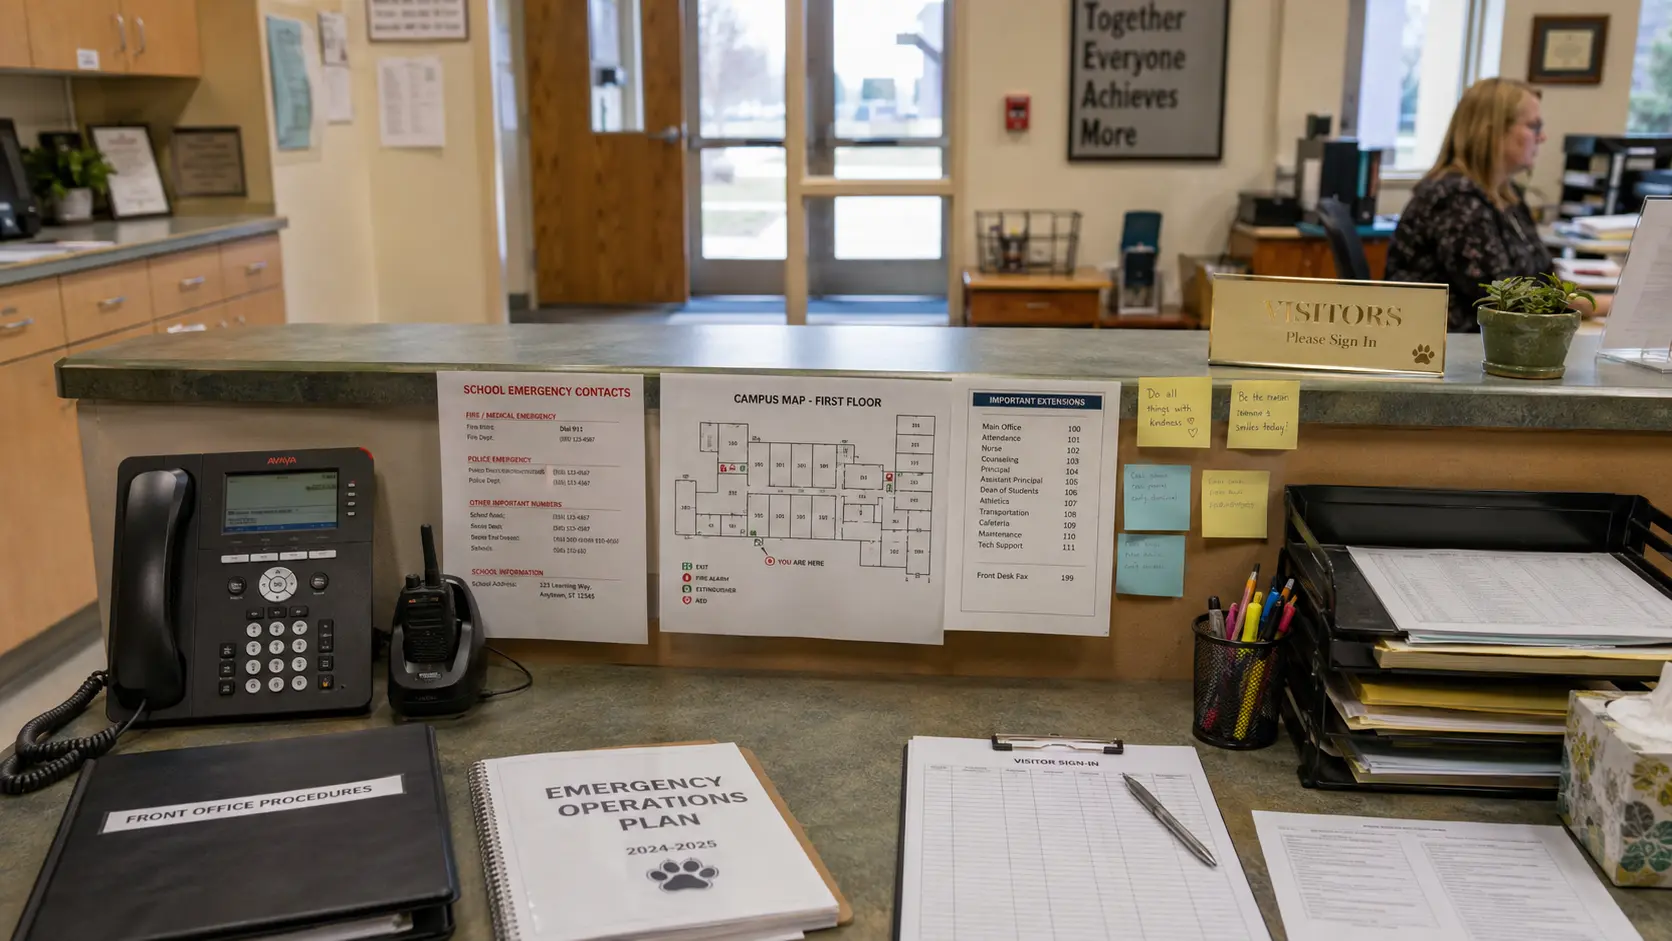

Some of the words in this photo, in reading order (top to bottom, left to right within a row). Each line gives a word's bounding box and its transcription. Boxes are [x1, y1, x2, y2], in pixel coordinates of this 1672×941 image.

[1085, 2, 1187, 40] Together
[1083, 40, 1186, 77] Everyone
[1082, 79, 1179, 109] Achieves
[1081, 118, 1138, 147] More
[1264, 300, 1402, 327] VISITORS
[1286, 332, 1326, 346] Please
[1329, 334, 1358, 350] Sign
[1363, 336, 1377, 348] In
[464, 385, 505, 395] SCHOOL
[508, 386, 571, 396] EMERGENCY
[575, 387, 631, 398] CONTACTS
[1146, 388, 1160, 399] Do
[1166, 389, 1177, 398] all
[1239, 391, 1248, 402] Be
[1253, 393, 1263, 401] the
[734, 394, 779, 405] CAMPUS
[782, 395, 806, 406] MAP
[816, 396, 844, 407] FIRST
[846, 397, 882, 407] FLOOR
[990, 396, 1035, 405] IMPORTANT
[1038, 398, 1085, 406] EXTENSIONS
[516, 412, 556, 420] EMERGENCY
[1147, 405, 1170, 417] things
[1174, 405, 1192, 413] with
[1150, 418, 1182, 427] kindness
[982, 434, 1021, 442] Attendance
[267, 456, 297, 466] AVAYA
[982, 456, 1019, 464] Counseling
[981, 466, 1010, 474] Principal
[1013, 477, 1043, 485] Principal
[1008, 487, 1039, 495] Students
[979, 508, 1029, 517] Transportation
[996, 542, 1023, 550] Support
[1014, 758, 1056, 766] VISITOR
[1058, 759, 1100, 767] SIGN-IN
[545, 776, 722, 800] EMERGENCY
[126, 809, 188, 824] FRONT
[193, 801, 255, 816] OFFICE
[259, 785, 373, 808] PROCEDURES
[558, 792, 749, 817] OPERATIONS
[619, 813, 701, 831] PLAN
[626, 840, 718, 856] 2024-2025
